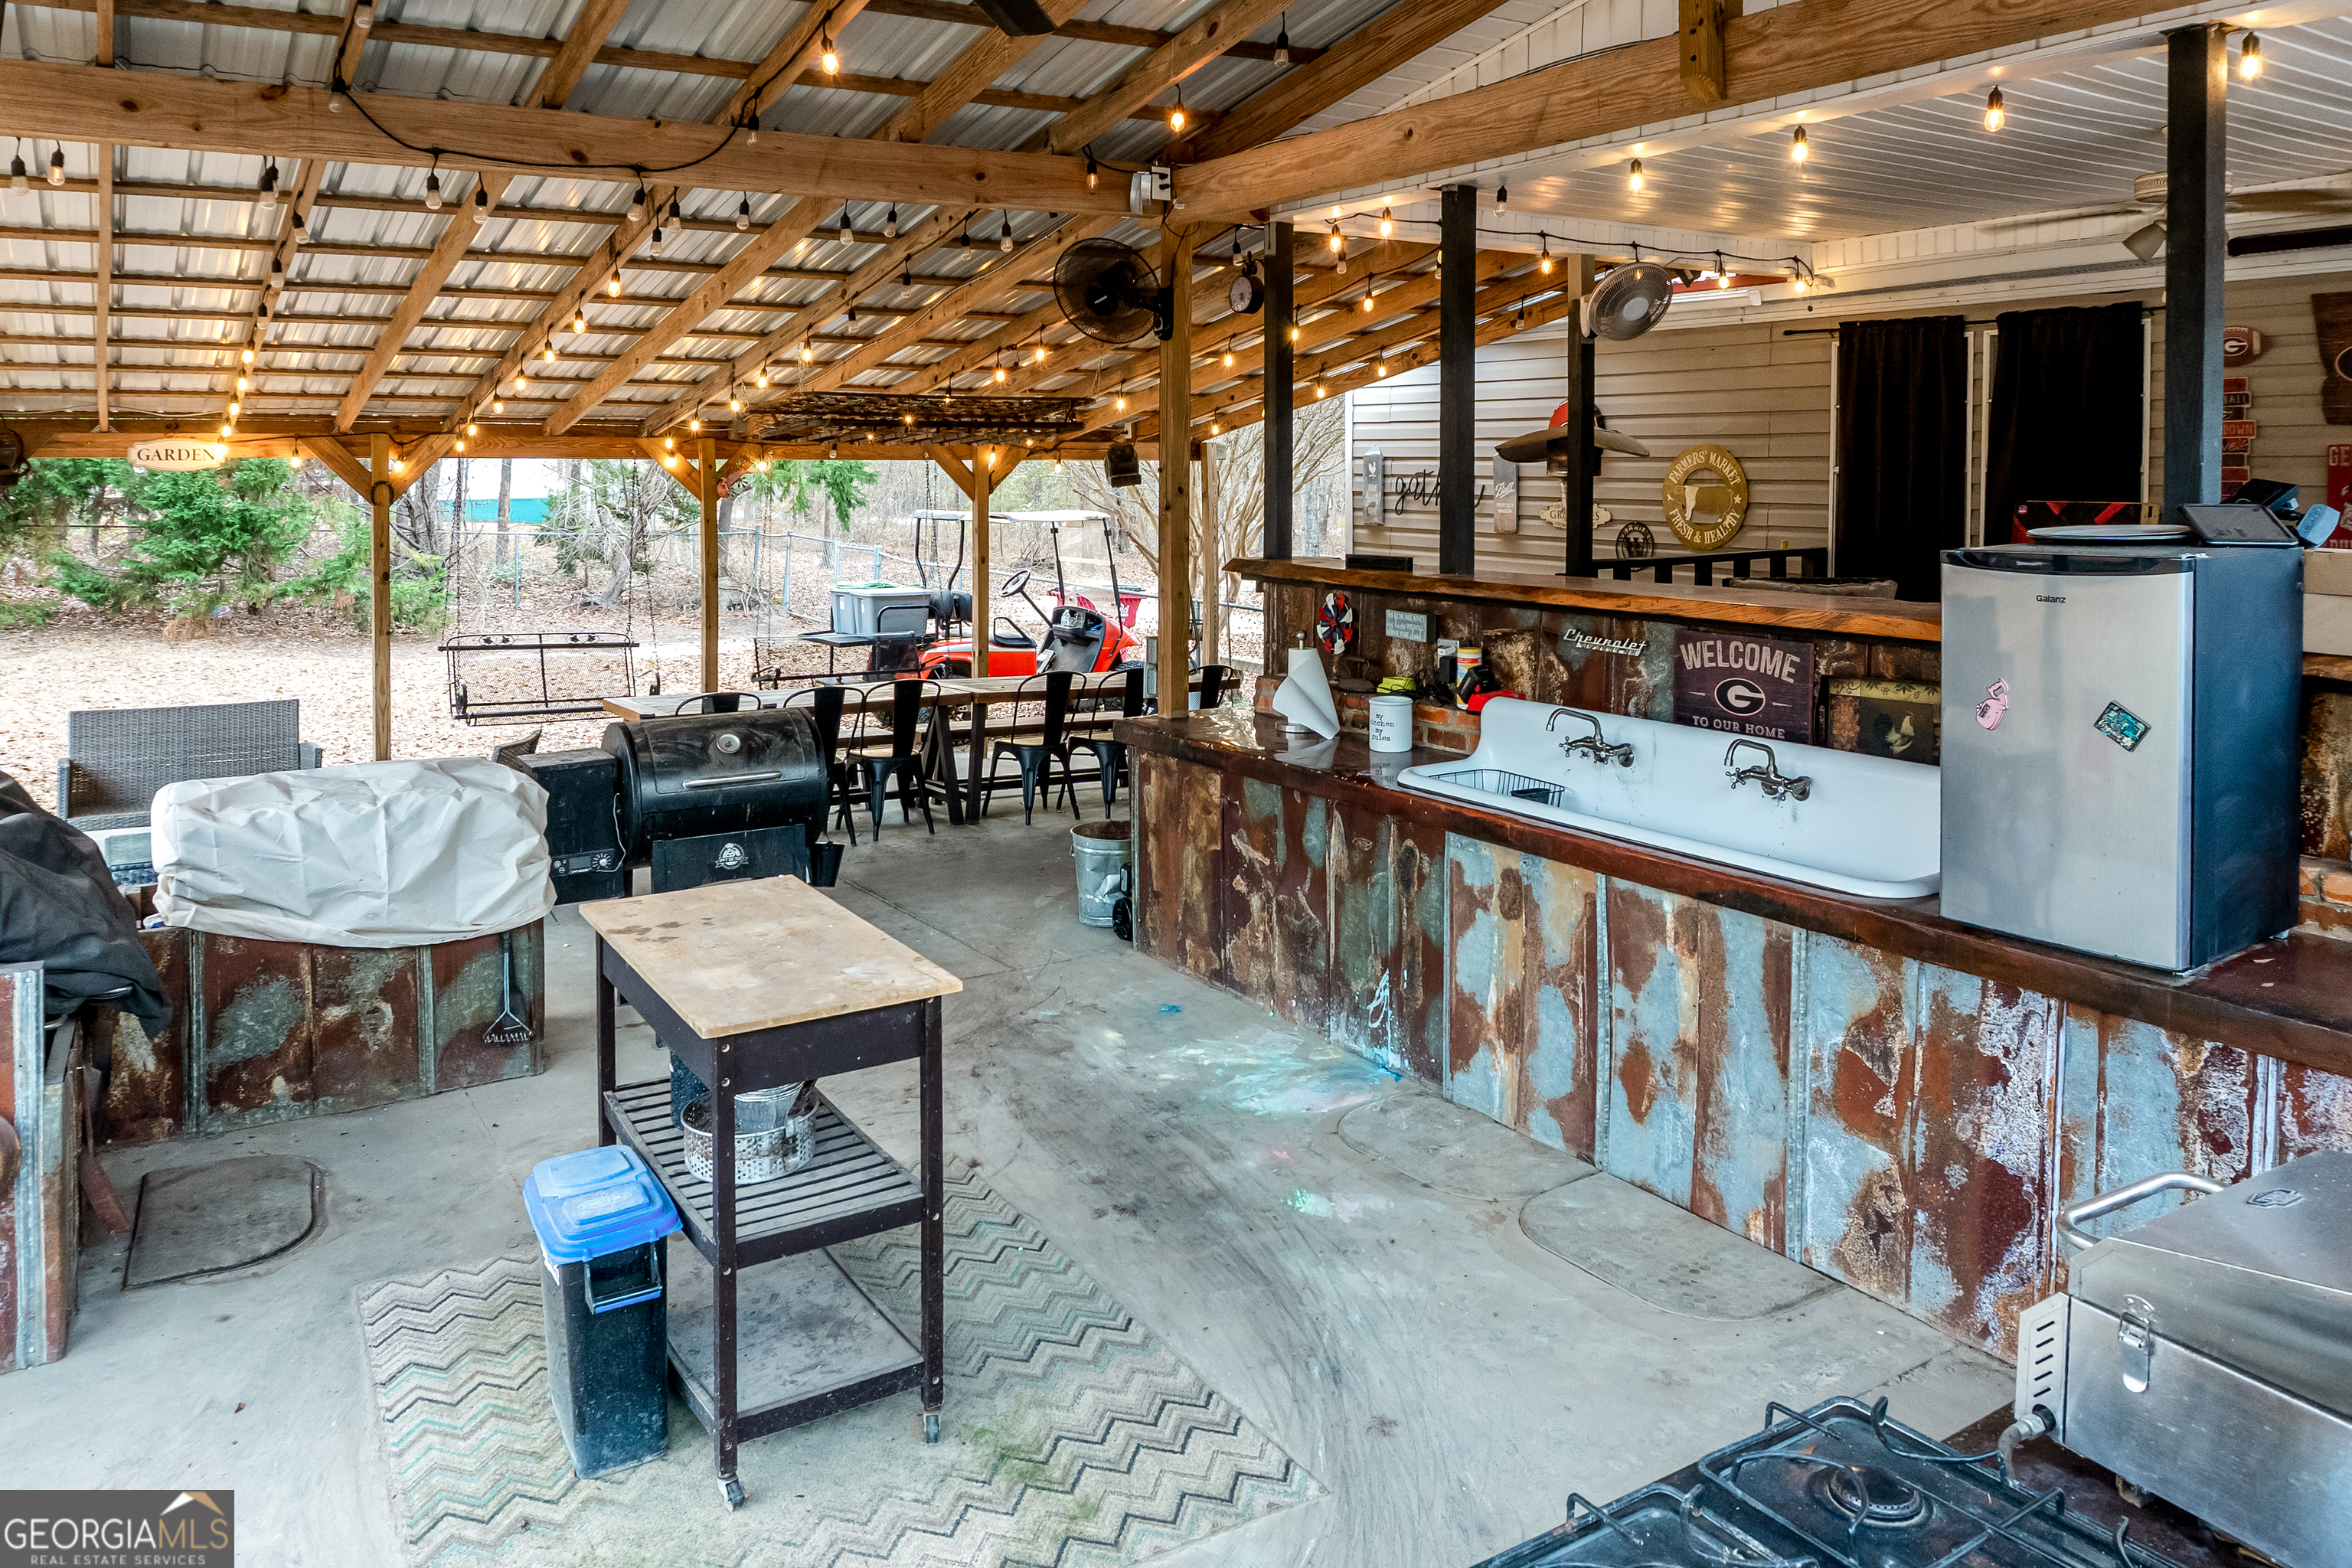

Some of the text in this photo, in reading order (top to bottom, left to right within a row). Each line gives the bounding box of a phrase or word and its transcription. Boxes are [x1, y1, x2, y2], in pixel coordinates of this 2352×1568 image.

[137, 448, 215, 461] GARDEN
[1708, 452, 1741, 485] MARKET
[1495, 482, 1515, 498] Ball
[1669, 508, 1694, 540] FRESH
[1694, 531, 1701, 543] &
[1704, 508, 1740, 544] HEALTHY
[2036, 594, 2066, 603] Galanz
[1563, 629, 1647, 651] Chevrolet
[1680, 639, 1800, 684] WELCOME
[1692, 715, 1785, 740] TO OUR HOME
